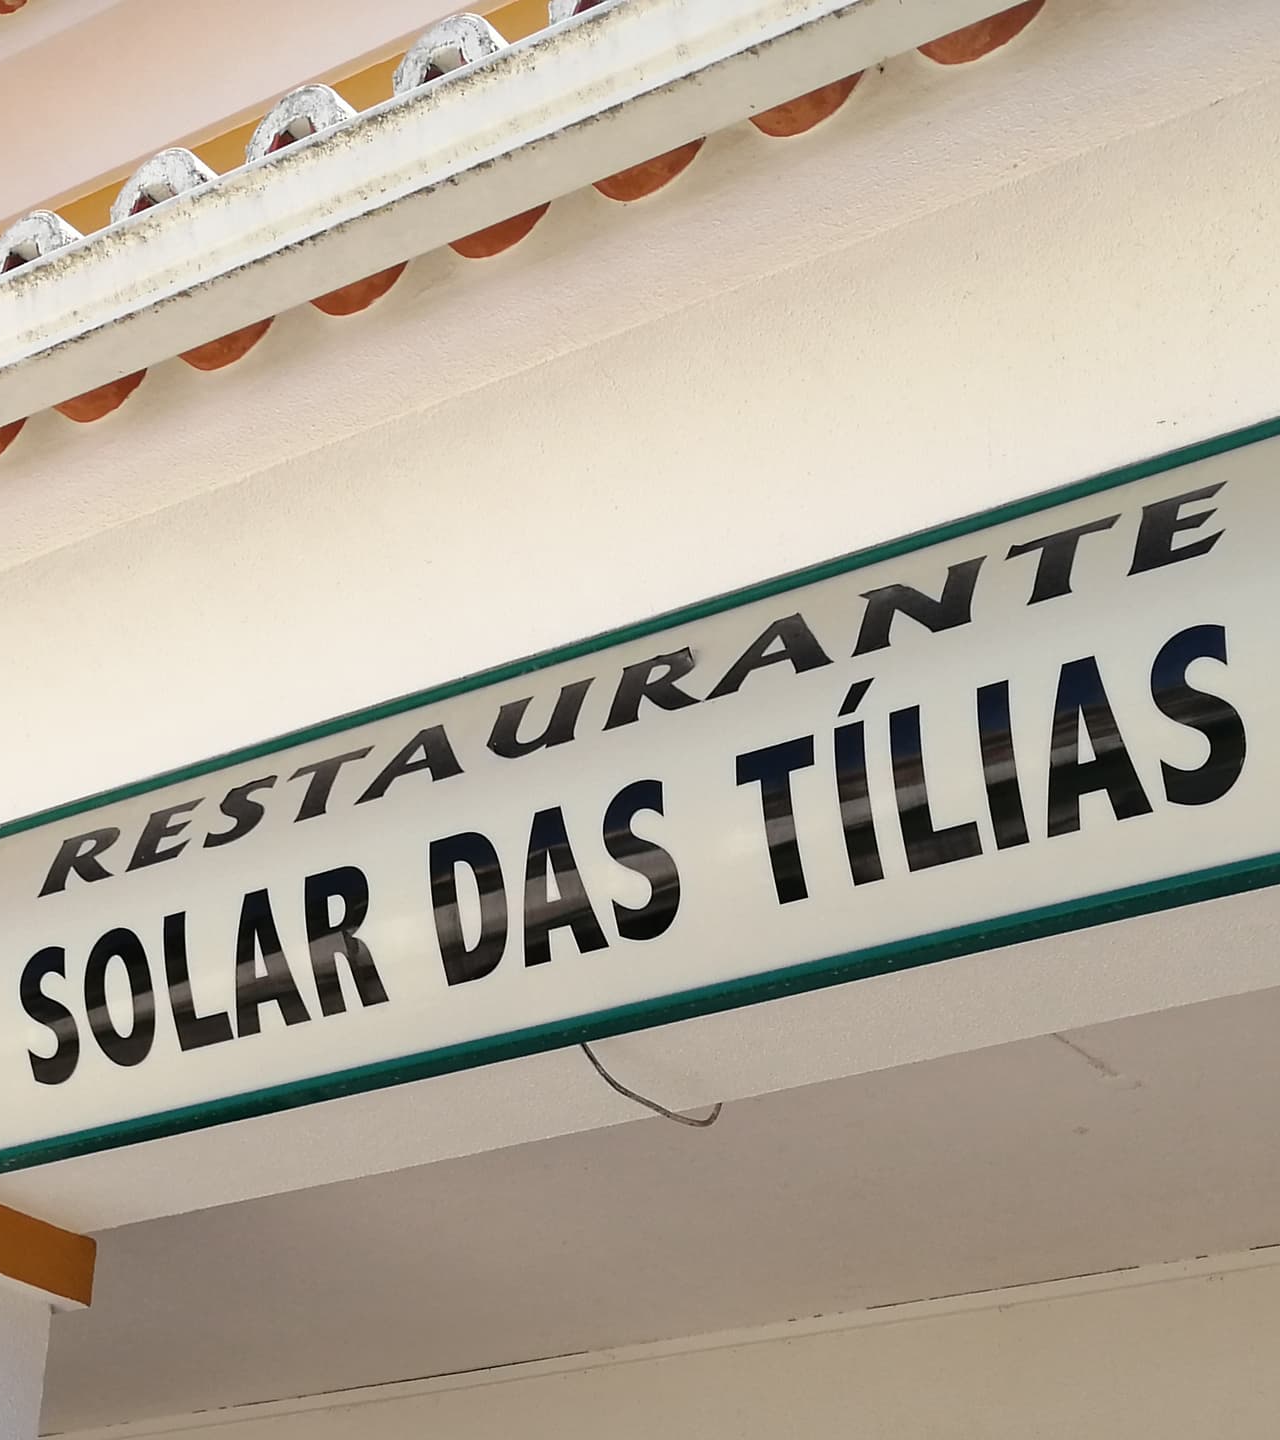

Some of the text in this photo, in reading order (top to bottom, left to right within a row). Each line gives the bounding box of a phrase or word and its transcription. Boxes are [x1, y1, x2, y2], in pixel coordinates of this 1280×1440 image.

[19, 624, 1247, 1086] SOLAR DAS TÍLIAS
[37, 481, 1228, 897] RESTAURANTE
